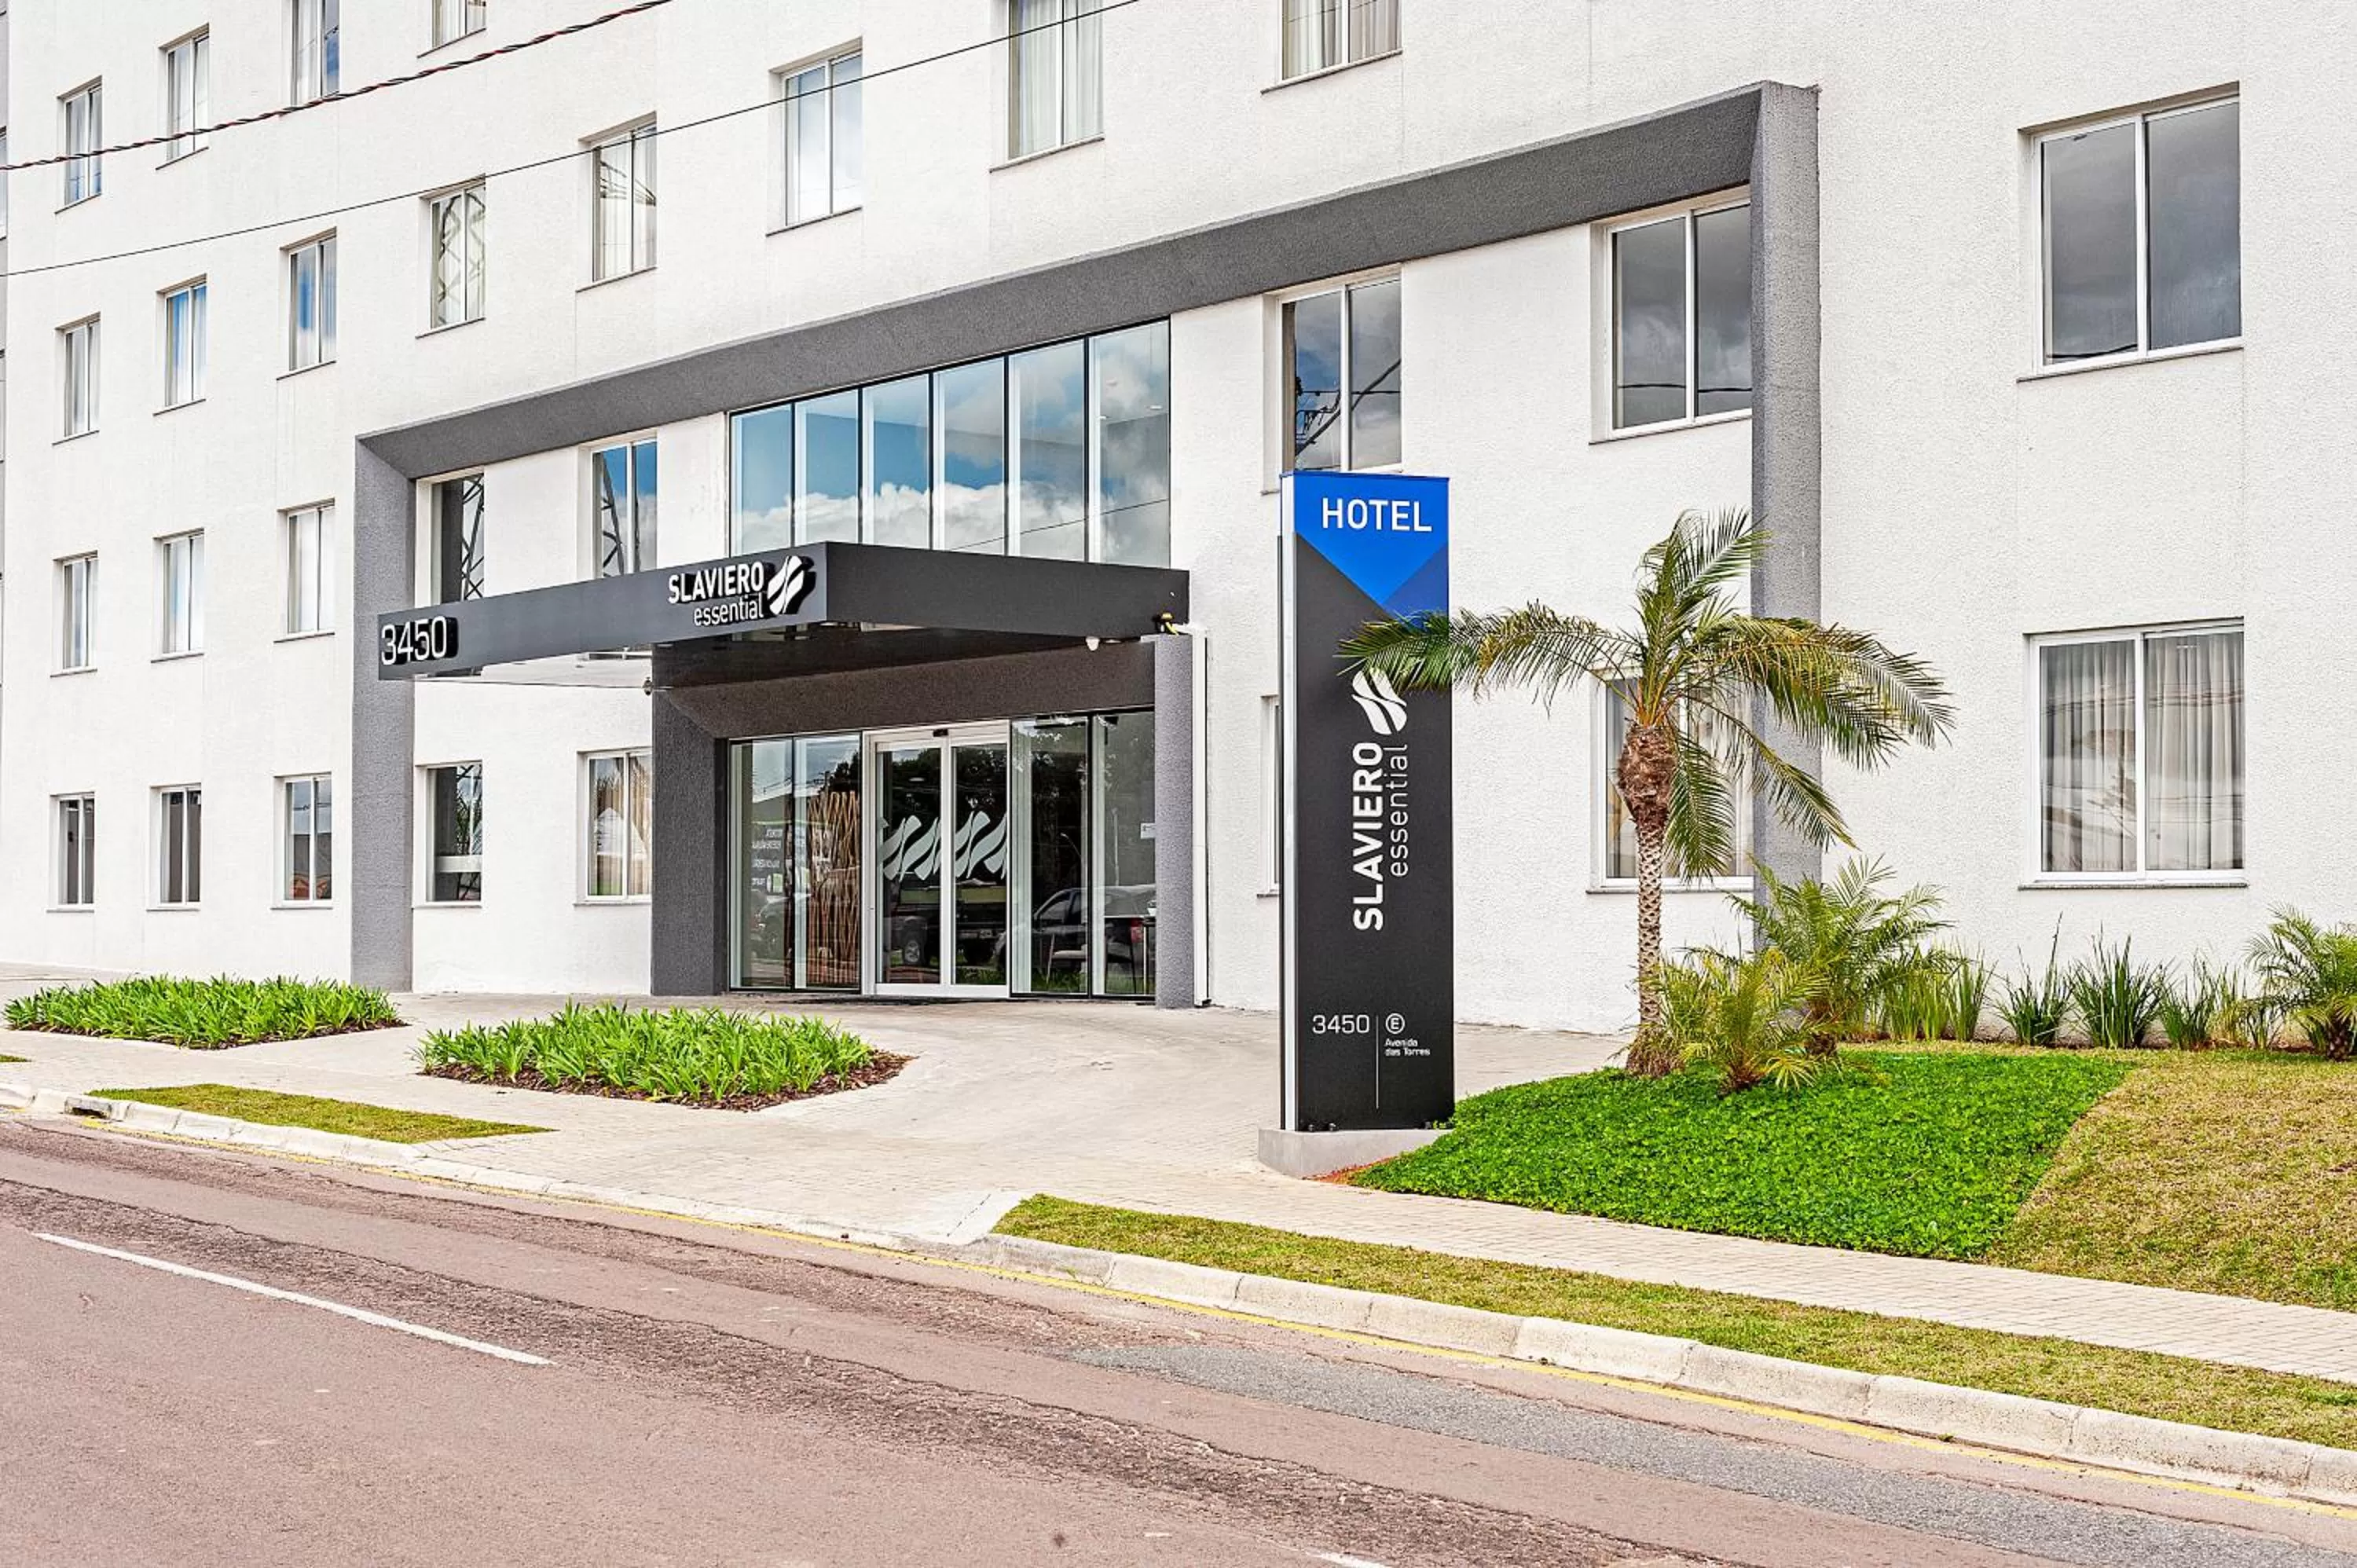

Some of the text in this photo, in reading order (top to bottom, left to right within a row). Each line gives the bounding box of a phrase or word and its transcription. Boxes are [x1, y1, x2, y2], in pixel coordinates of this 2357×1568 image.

[1322, 497, 1432, 532] HOTEL
[668, 561, 764, 604] SLAVIERO
[694, 592, 764, 626] essential
[381, 616, 447, 665] 3450
[1383, 744, 1408, 877] essential
[1352, 742, 1384, 931] SLAVIERO
[1312, 1014, 1370, 1035] 3450
[1384, 1038, 1418, 1046] Avenida
[1385, 1047, 1431, 1057] das Torres
